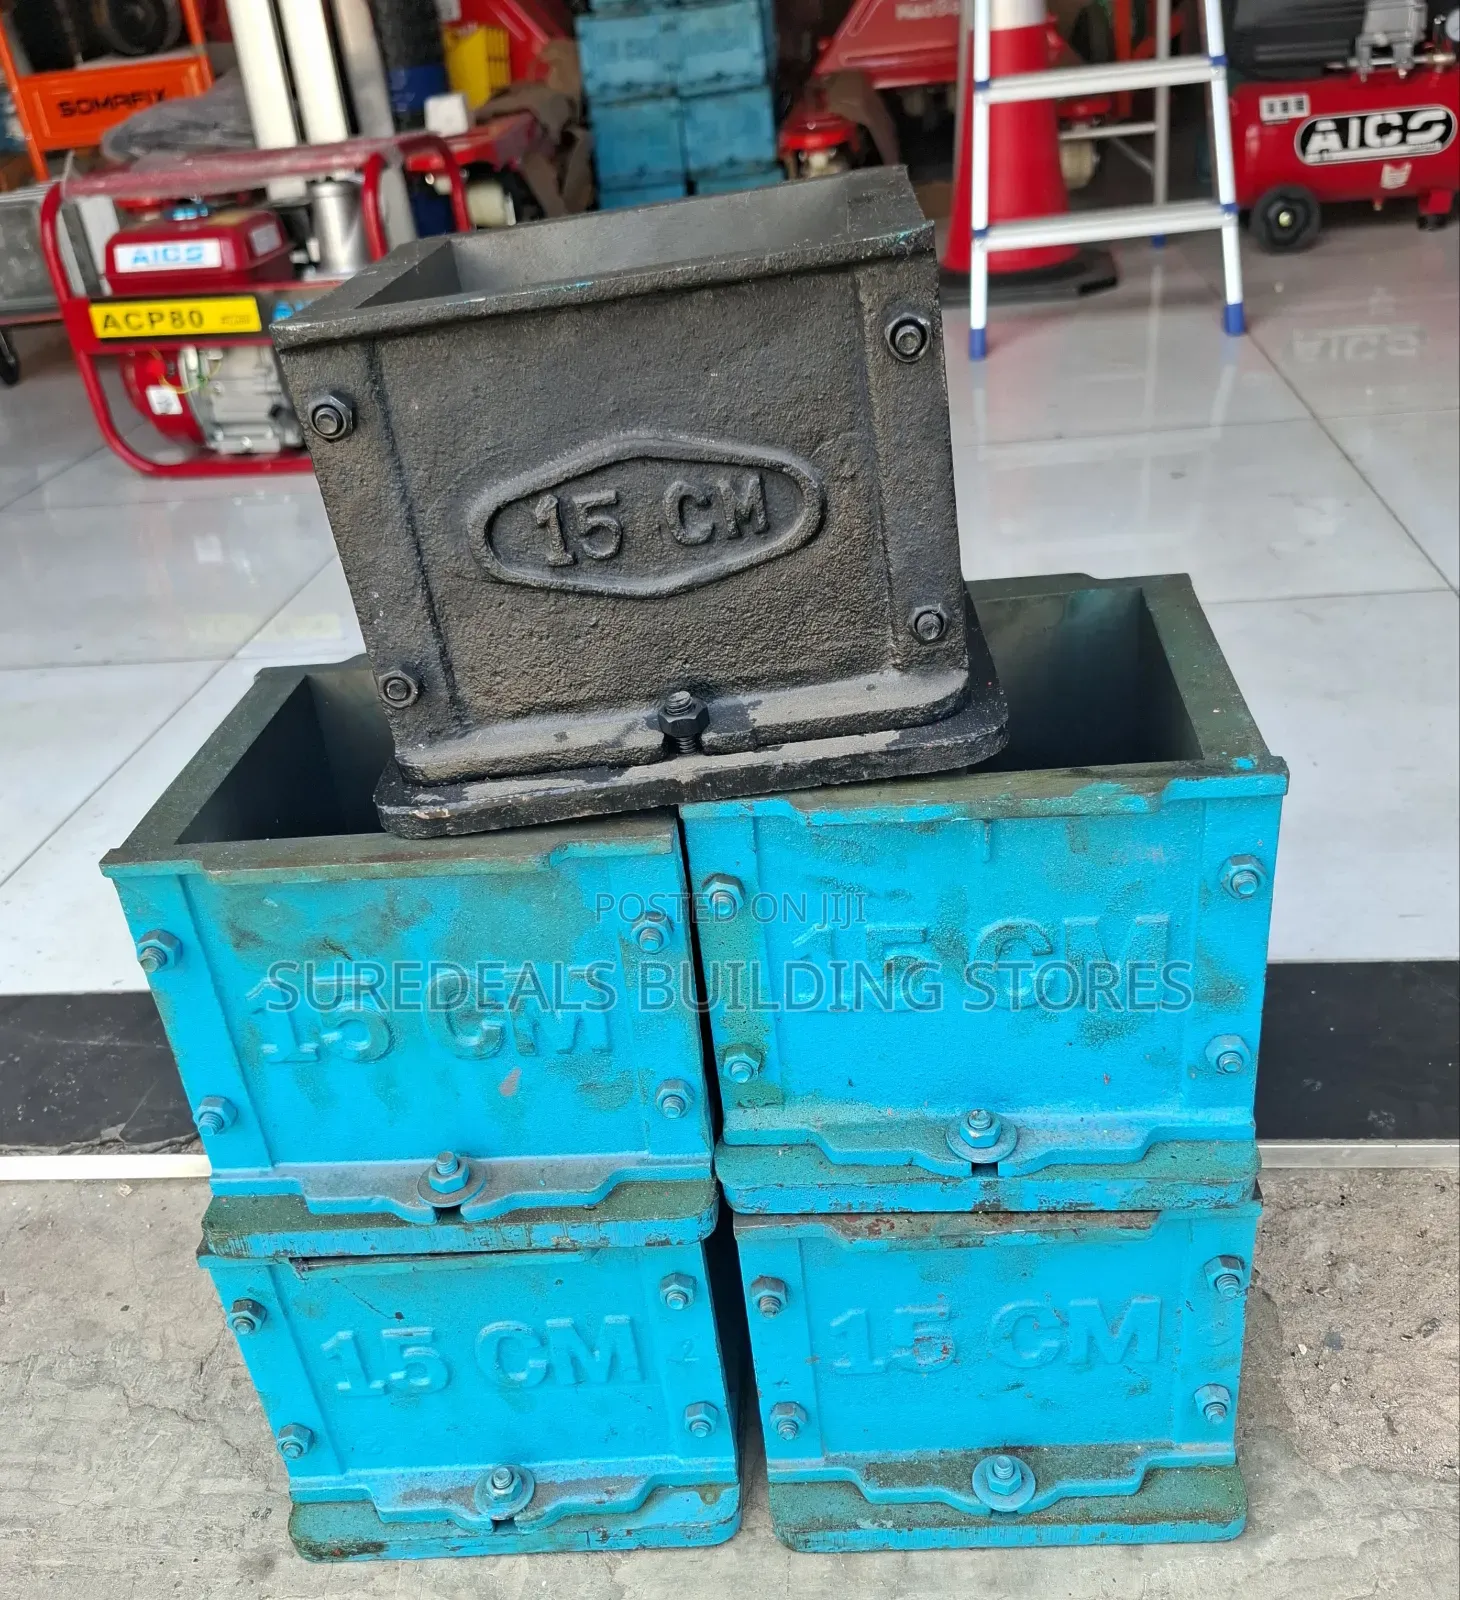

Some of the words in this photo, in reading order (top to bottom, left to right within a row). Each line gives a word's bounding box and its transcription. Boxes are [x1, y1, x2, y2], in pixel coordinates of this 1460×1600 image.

[1305, 109, 1447, 163] AICS
[131, 243, 205, 266] AICS
[101, 308, 206, 332] ACP80
[535, 489, 623, 567] 15
[663, 473, 770, 547] CM
[792, 922, 932, 1014] 15
[966, 914, 1172, 1012] CM
[246, 972, 395, 1064] 15
[424, 966, 612, 1060] CM
[320, 1326, 452, 1396] 15
[475, 1314, 648, 1389] CM
[828, 1303, 957, 1376] 15
[990, 1295, 1163, 1370] CM
